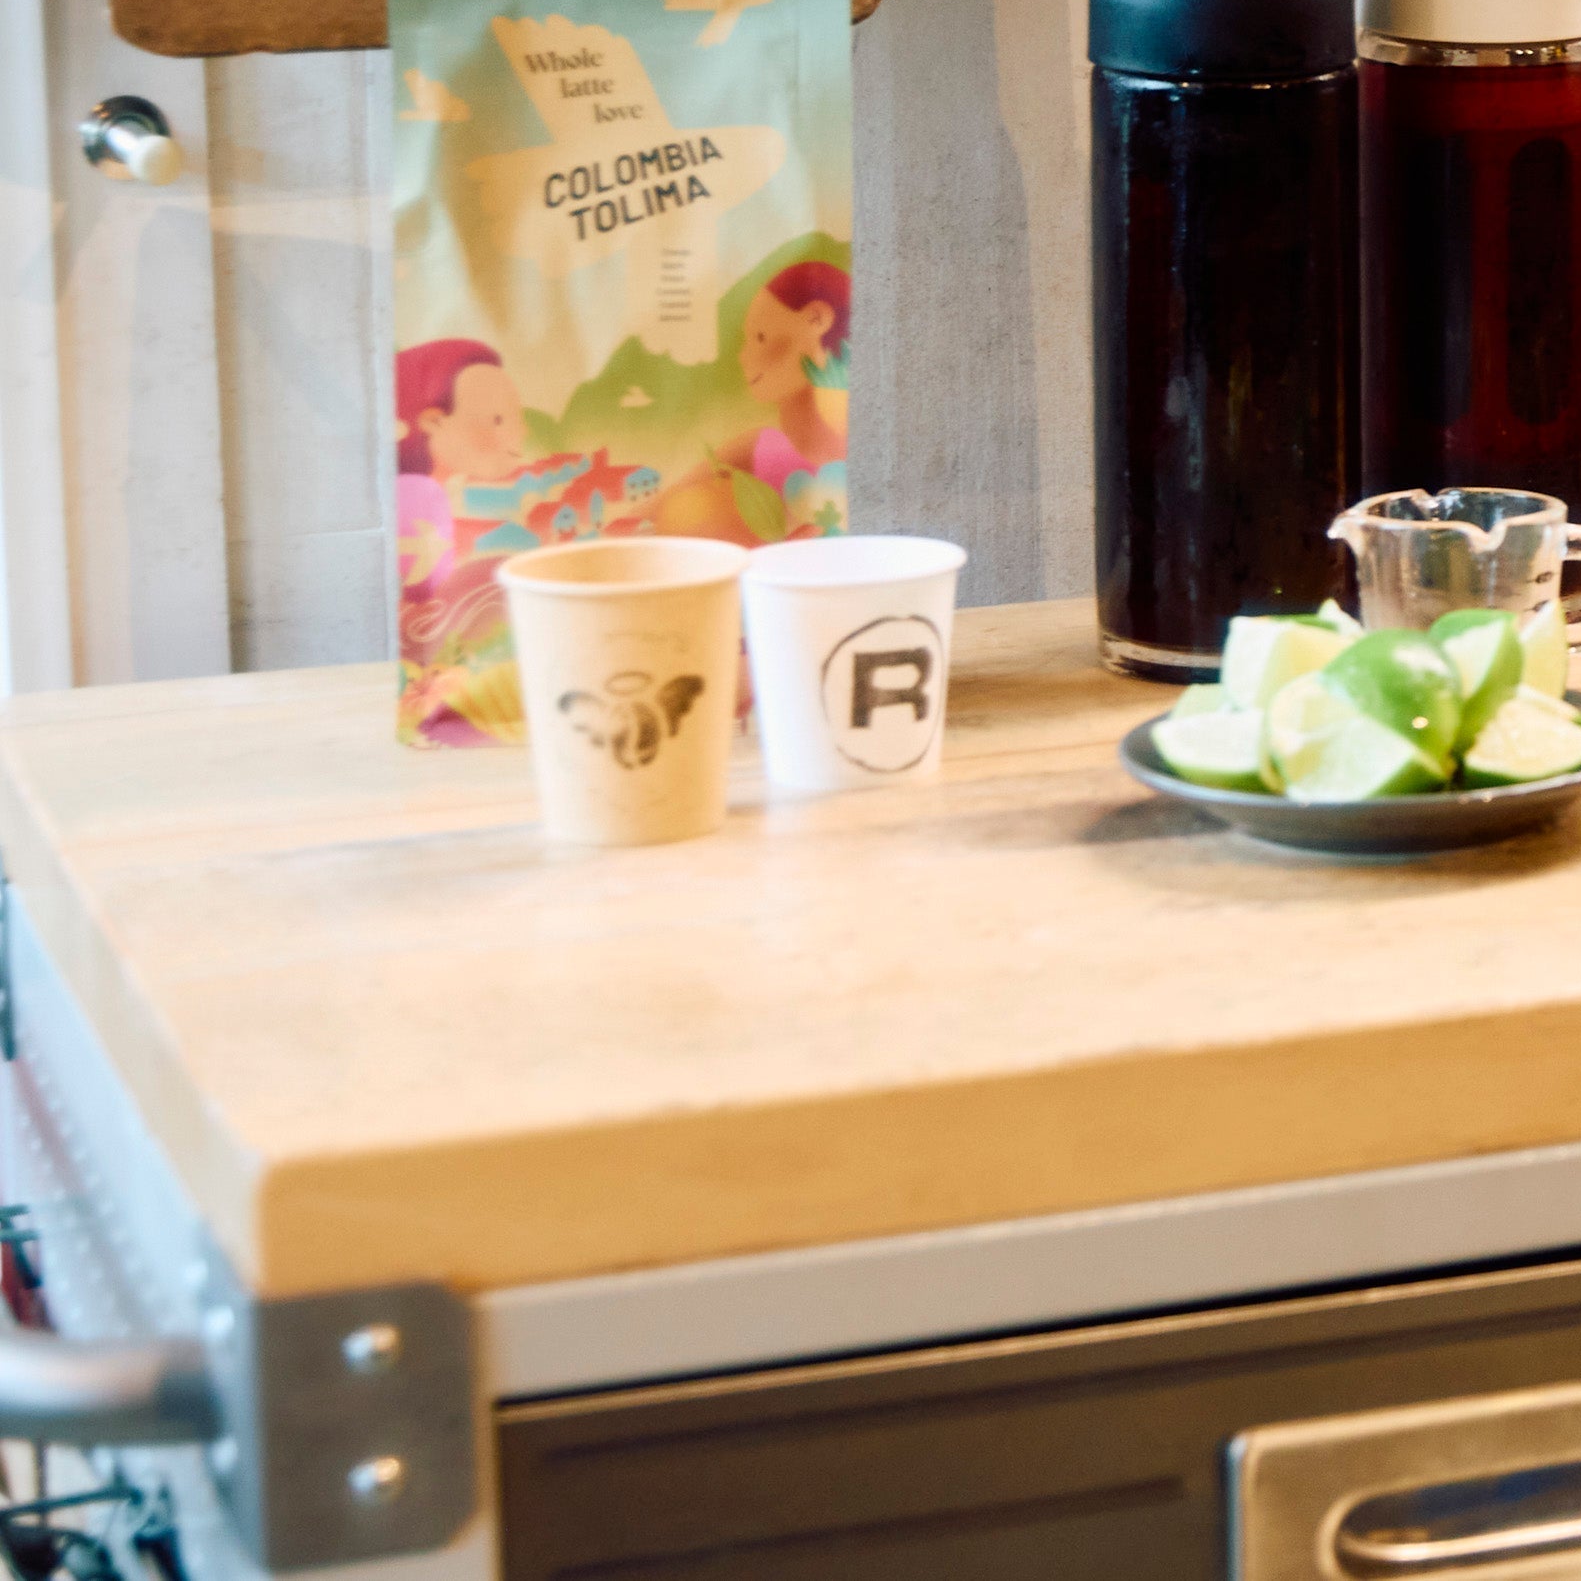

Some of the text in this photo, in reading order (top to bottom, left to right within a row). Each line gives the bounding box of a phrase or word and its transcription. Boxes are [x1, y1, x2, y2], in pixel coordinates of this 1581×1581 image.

[525, 48, 604, 73] Whole
[559, 77, 615, 98] latte
[593, 103, 644, 124] love
[543, 135, 723, 209] COLOMBIA
[568, 174, 711, 242] TOLIMA
[849, 646, 932, 730] R
